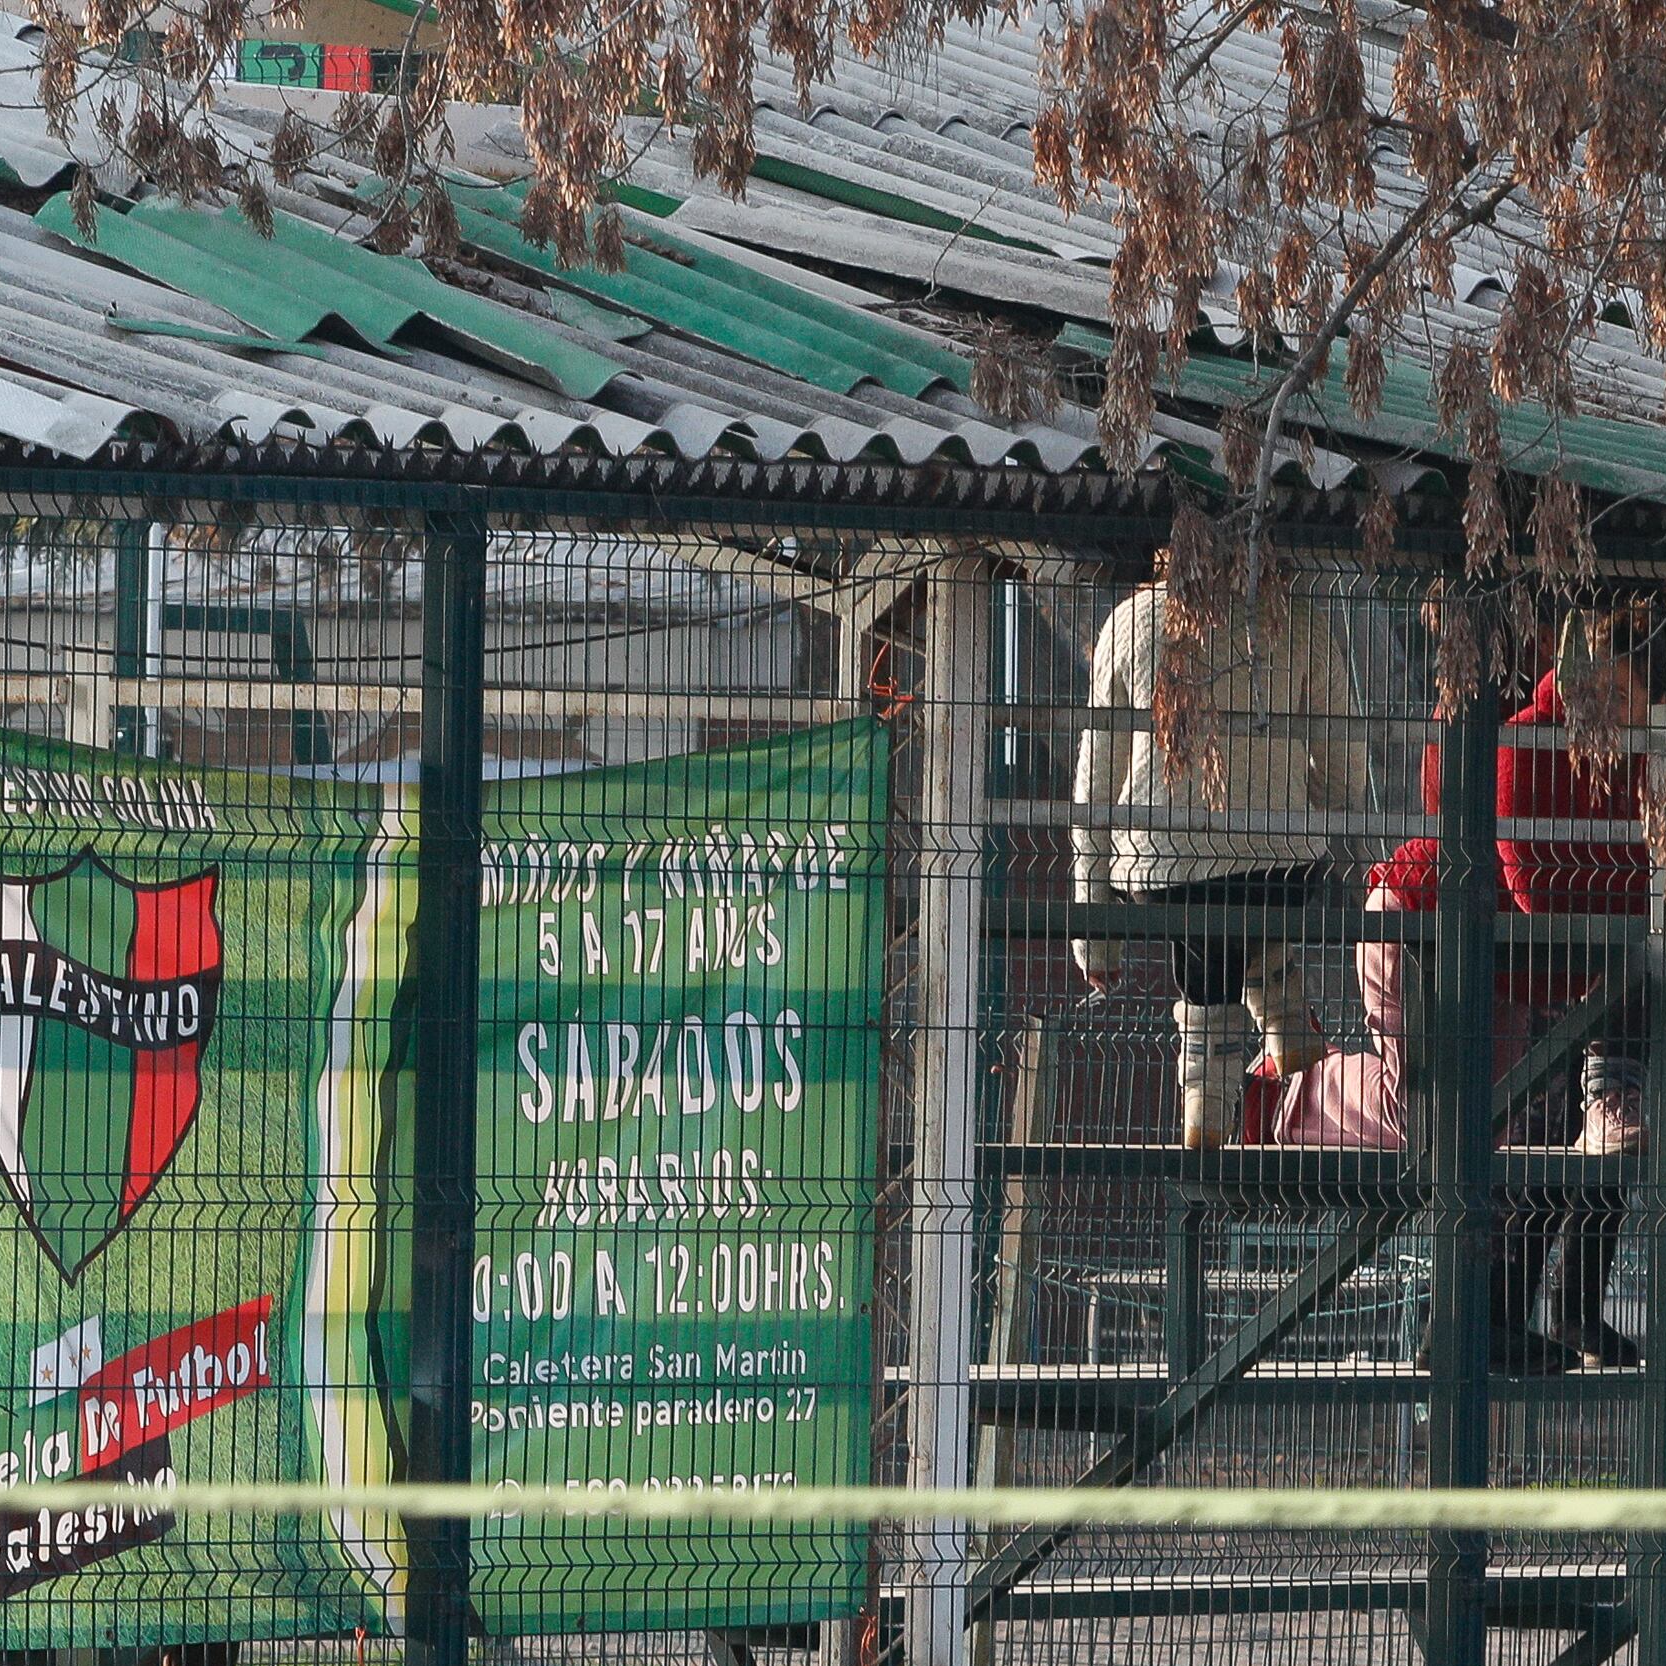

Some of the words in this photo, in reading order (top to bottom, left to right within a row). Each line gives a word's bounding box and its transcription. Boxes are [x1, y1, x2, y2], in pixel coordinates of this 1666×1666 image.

[102, 775, 217, 829] COLINA
[624, 839, 648, 902] Y
[660, 824, 787, 900] NIÑAS
[794, 824, 848, 891] DE
[539, 912, 563, 976] 5
[583, 911, 610, 975] A
[623, 908, 667, 974] 17
[688, 898, 782, 974] AÑOS
[596, 1249, 627, 1316] A
[84, 1396, 122, 1457] De
[132, 1320, 269, 1429] Futbol
[483, 1350, 634, 1385] Caletera
[648, 1343, 702, 1380] San
[636, 1388, 775, 1436] paradero
[786, 1386, 817, 1422] 27
